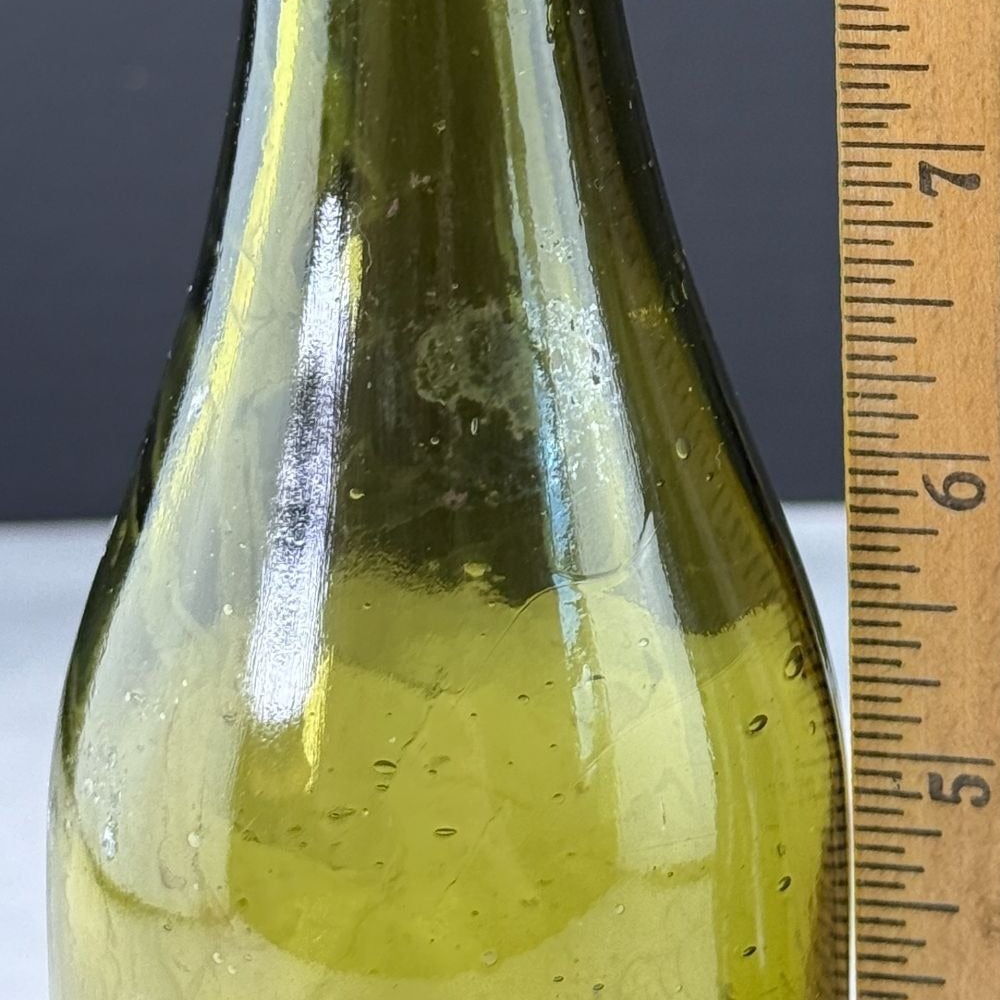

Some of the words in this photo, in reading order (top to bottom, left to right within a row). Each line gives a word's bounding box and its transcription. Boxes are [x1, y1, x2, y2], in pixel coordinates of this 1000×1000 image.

[918, 160, 982, 198] 7
[921, 471, 987, 512] 6
[927, 772, 991, 808] 5
